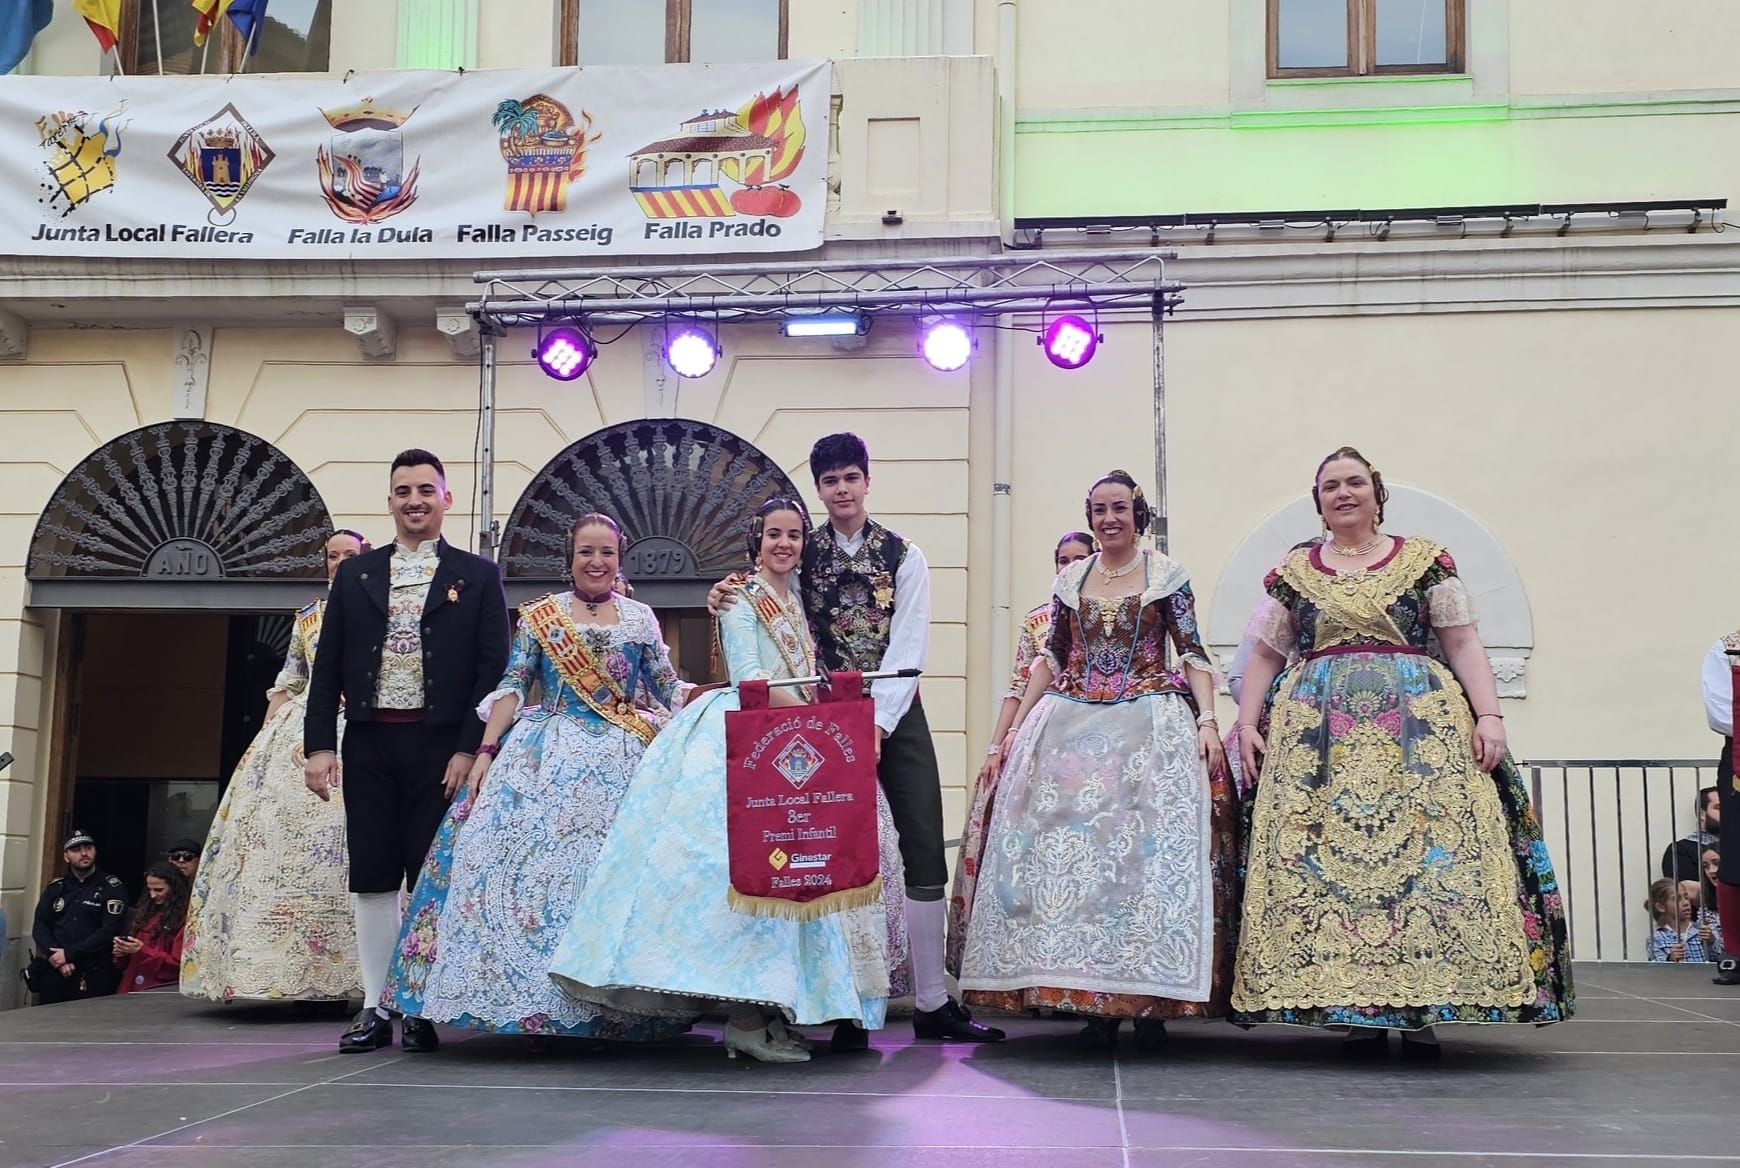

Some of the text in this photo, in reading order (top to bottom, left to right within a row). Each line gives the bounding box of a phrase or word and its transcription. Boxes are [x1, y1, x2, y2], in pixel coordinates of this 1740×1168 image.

[31, 223, 254, 244] Junta Local Fallera
[287, 227, 433, 244] Falla la Dula
[457, 224, 613, 246] Falla Passeig
[643, 218, 782, 240] Falla Prado
[157, 544, 209, 576] AÑO
[630, 548, 687, 575] 1879
[743, 715, 856, 770] Federació de Falles
[746, 790, 854, 809] Junta Local Fallera
[787, 809, 812, 824] 3er
[762, 826, 837, 842] Premi Infantil
[790, 853, 832, 863] Ginestar
[771, 874, 832, 889] Falles 2024
